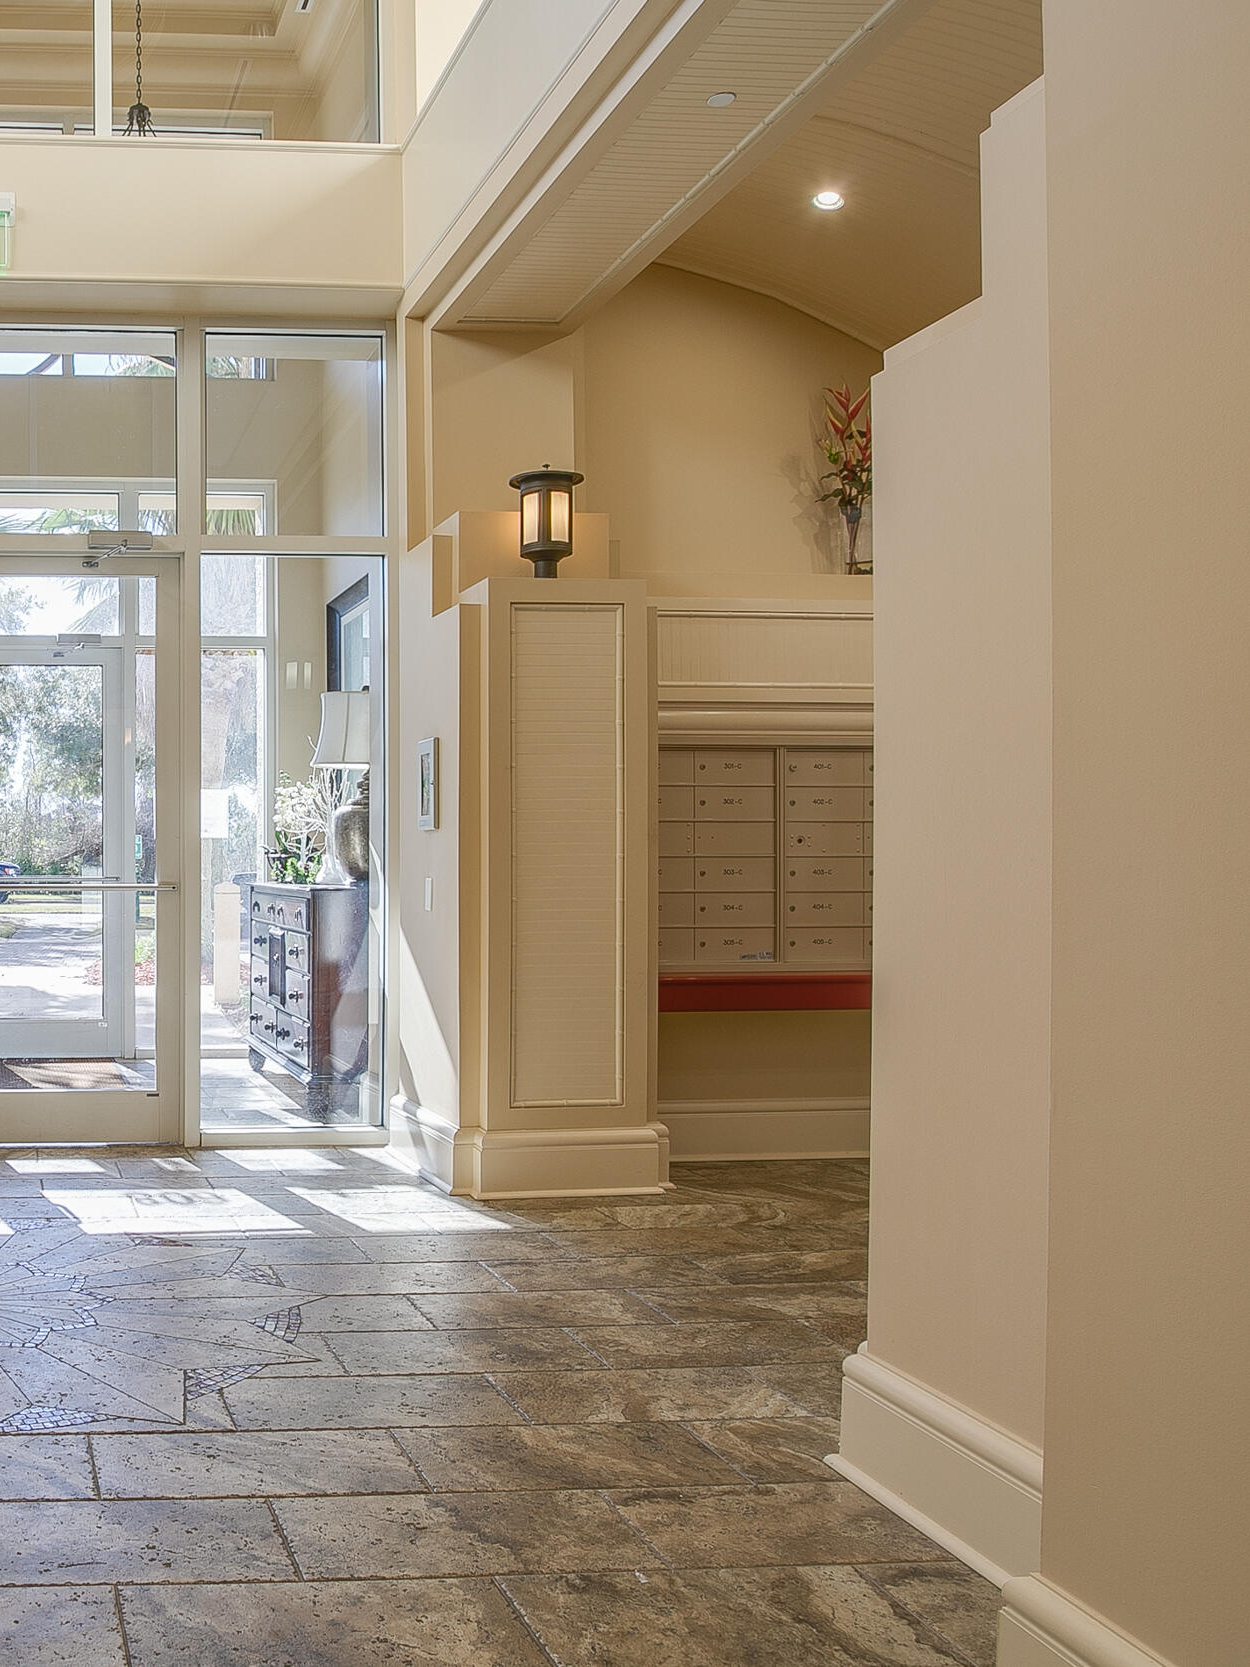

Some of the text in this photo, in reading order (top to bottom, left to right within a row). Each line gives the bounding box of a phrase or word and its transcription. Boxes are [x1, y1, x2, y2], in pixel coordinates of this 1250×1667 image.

[723, 762, 742, 770] 301-C
[813, 763, 832, 771] 401-C
[722, 798, 743, 806] 302-C
[812, 798, 833, 806] 402-C
[722, 904, 743, 912] 304-C
[812, 903, 833, 911] 404-C
